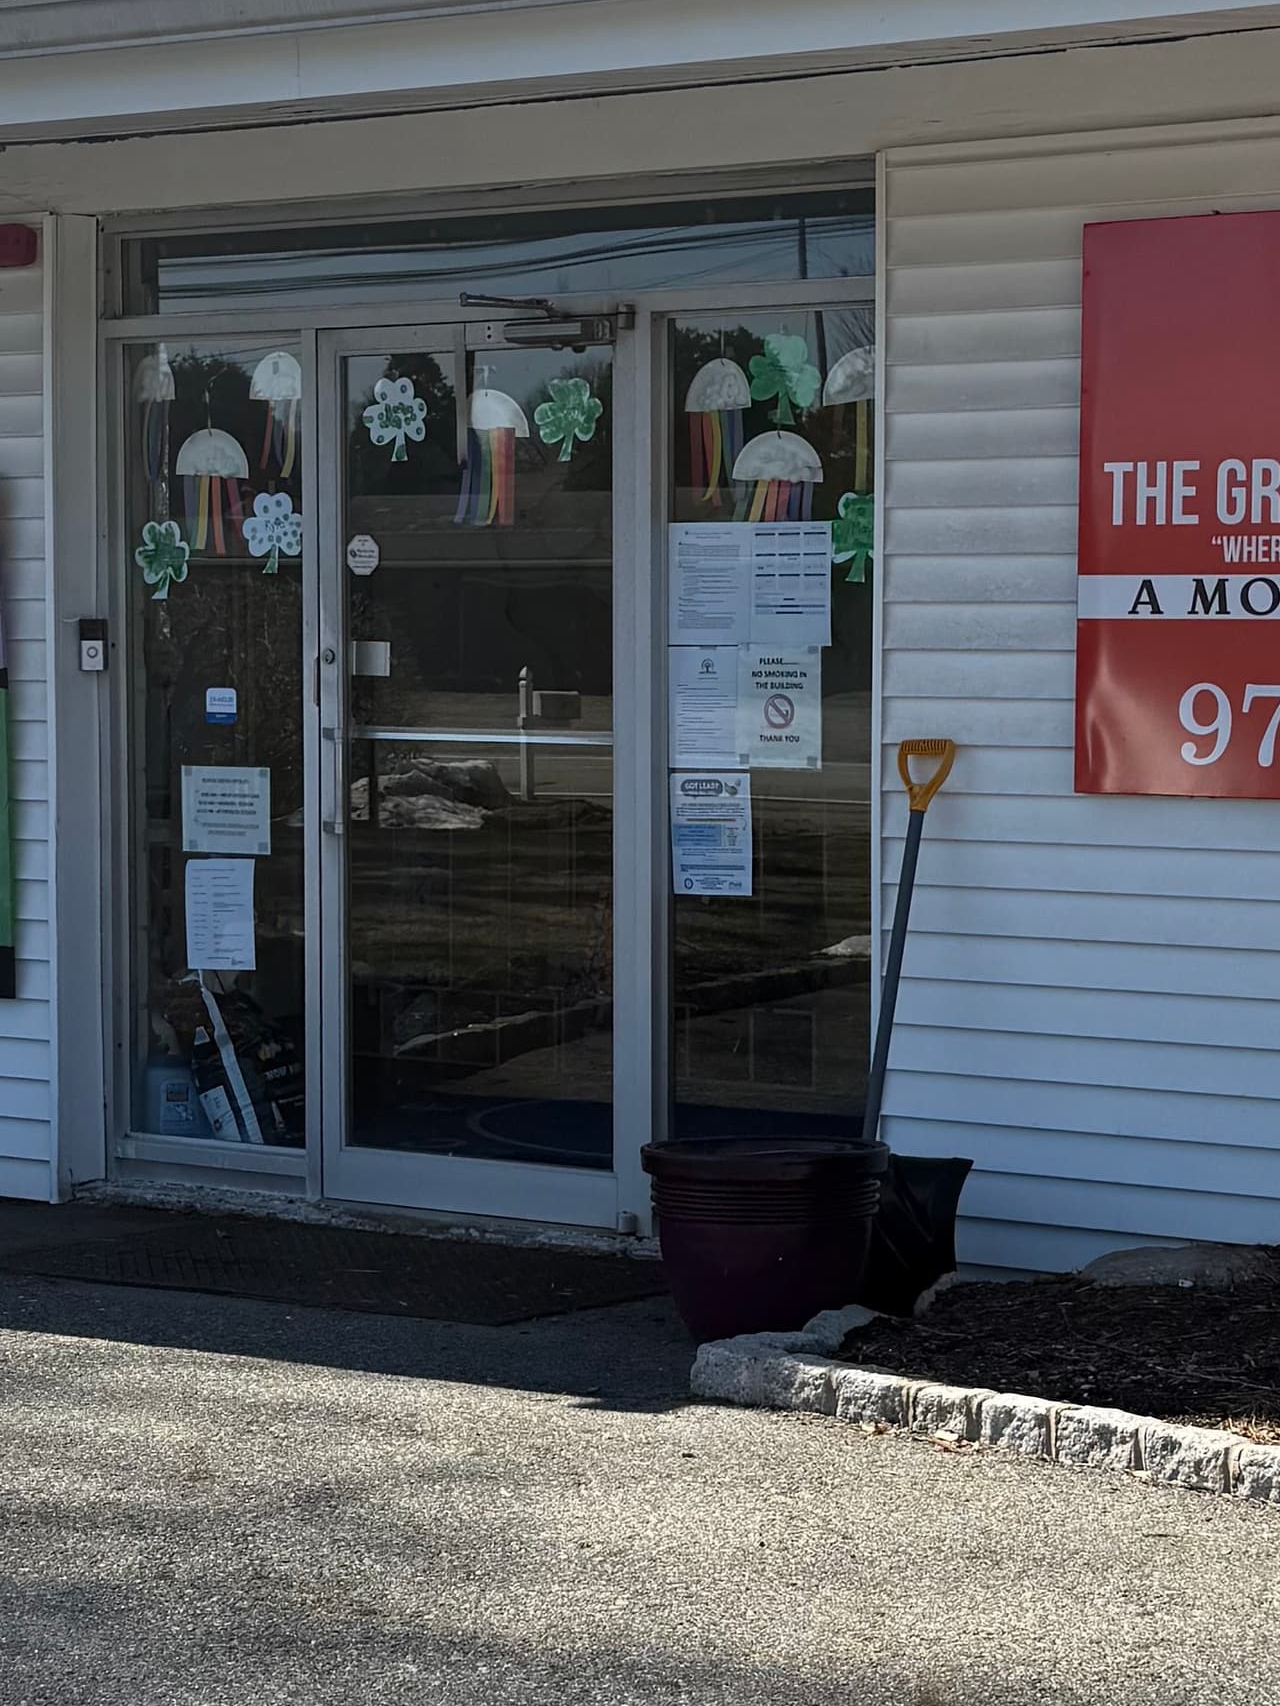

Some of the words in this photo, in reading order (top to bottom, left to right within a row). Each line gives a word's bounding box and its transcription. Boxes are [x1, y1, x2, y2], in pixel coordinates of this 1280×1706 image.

[1103, 459, 1200, 526] THE
[1128, 579, 1163, 615] A
[755, 681, 768, 689] THE
